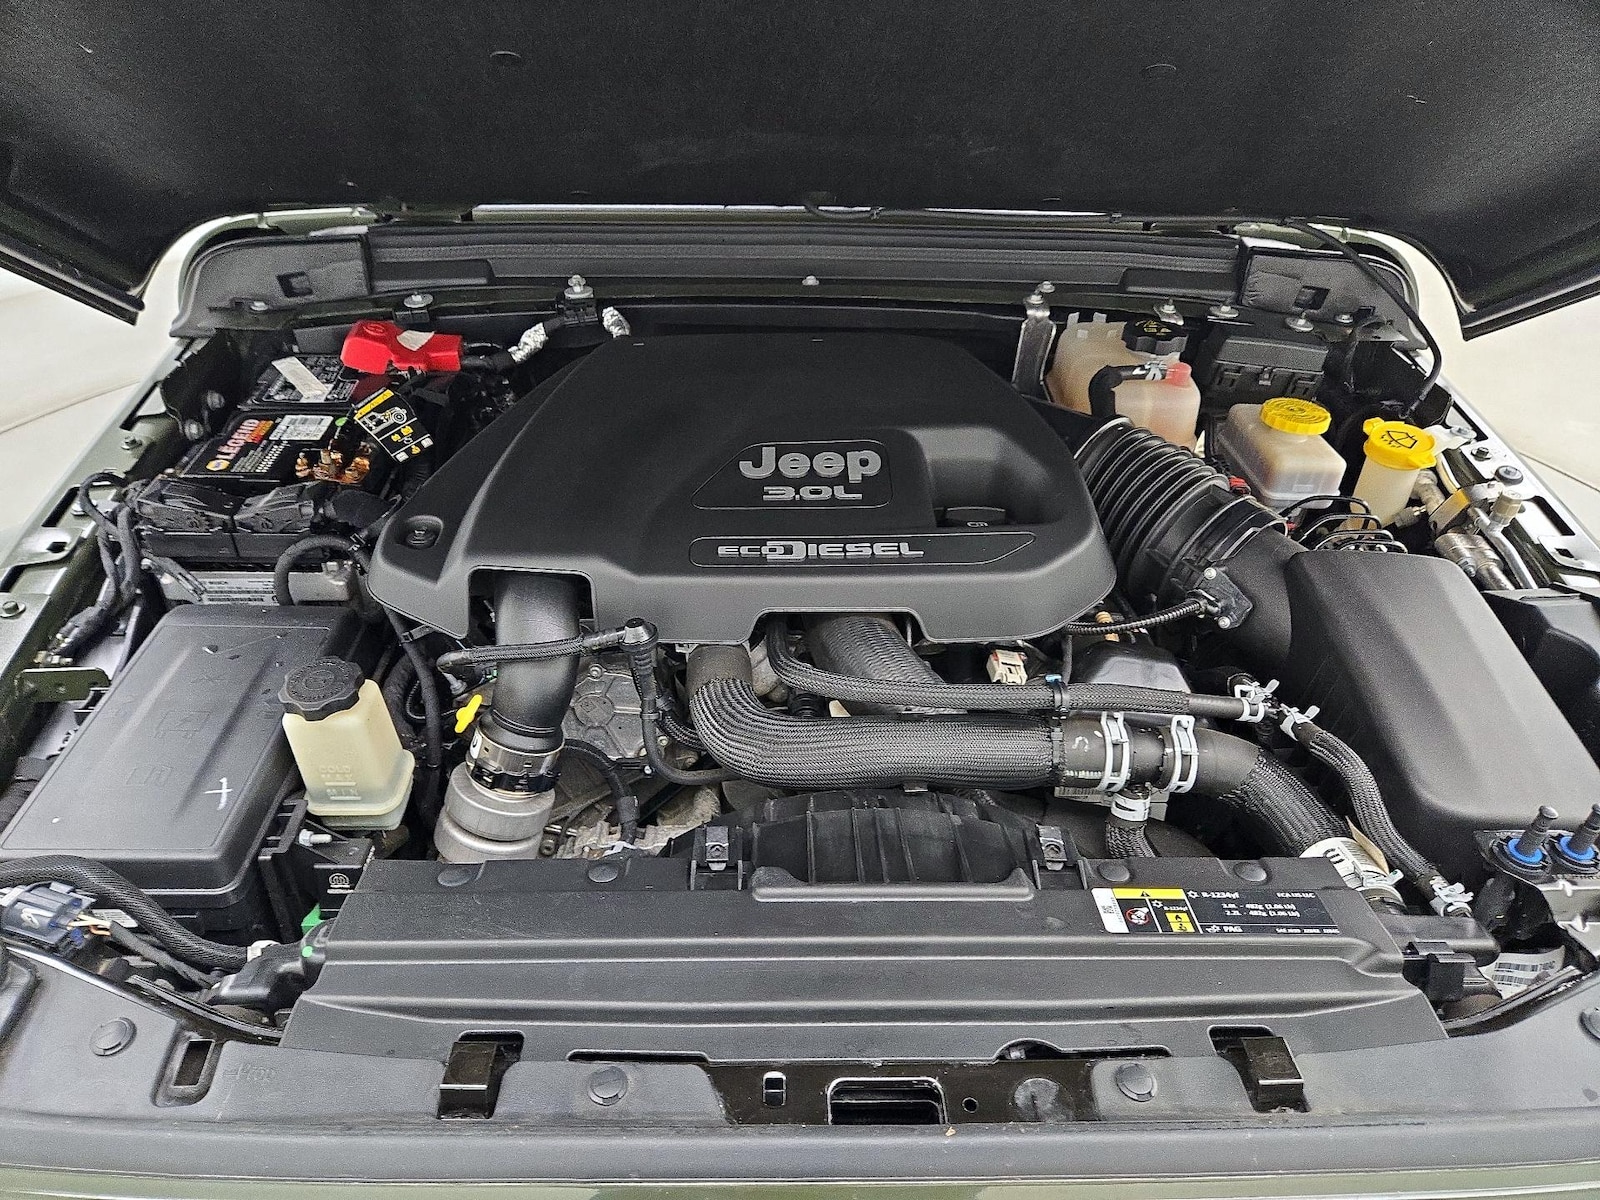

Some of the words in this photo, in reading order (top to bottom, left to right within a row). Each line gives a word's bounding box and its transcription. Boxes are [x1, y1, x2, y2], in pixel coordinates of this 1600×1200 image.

[215, 419, 260, 460] LEGEND
[738, 446, 882, 484] Jeep
[762, 485, 863, 502] 3.0L
[1222, 925, 1243, 933] PAG
